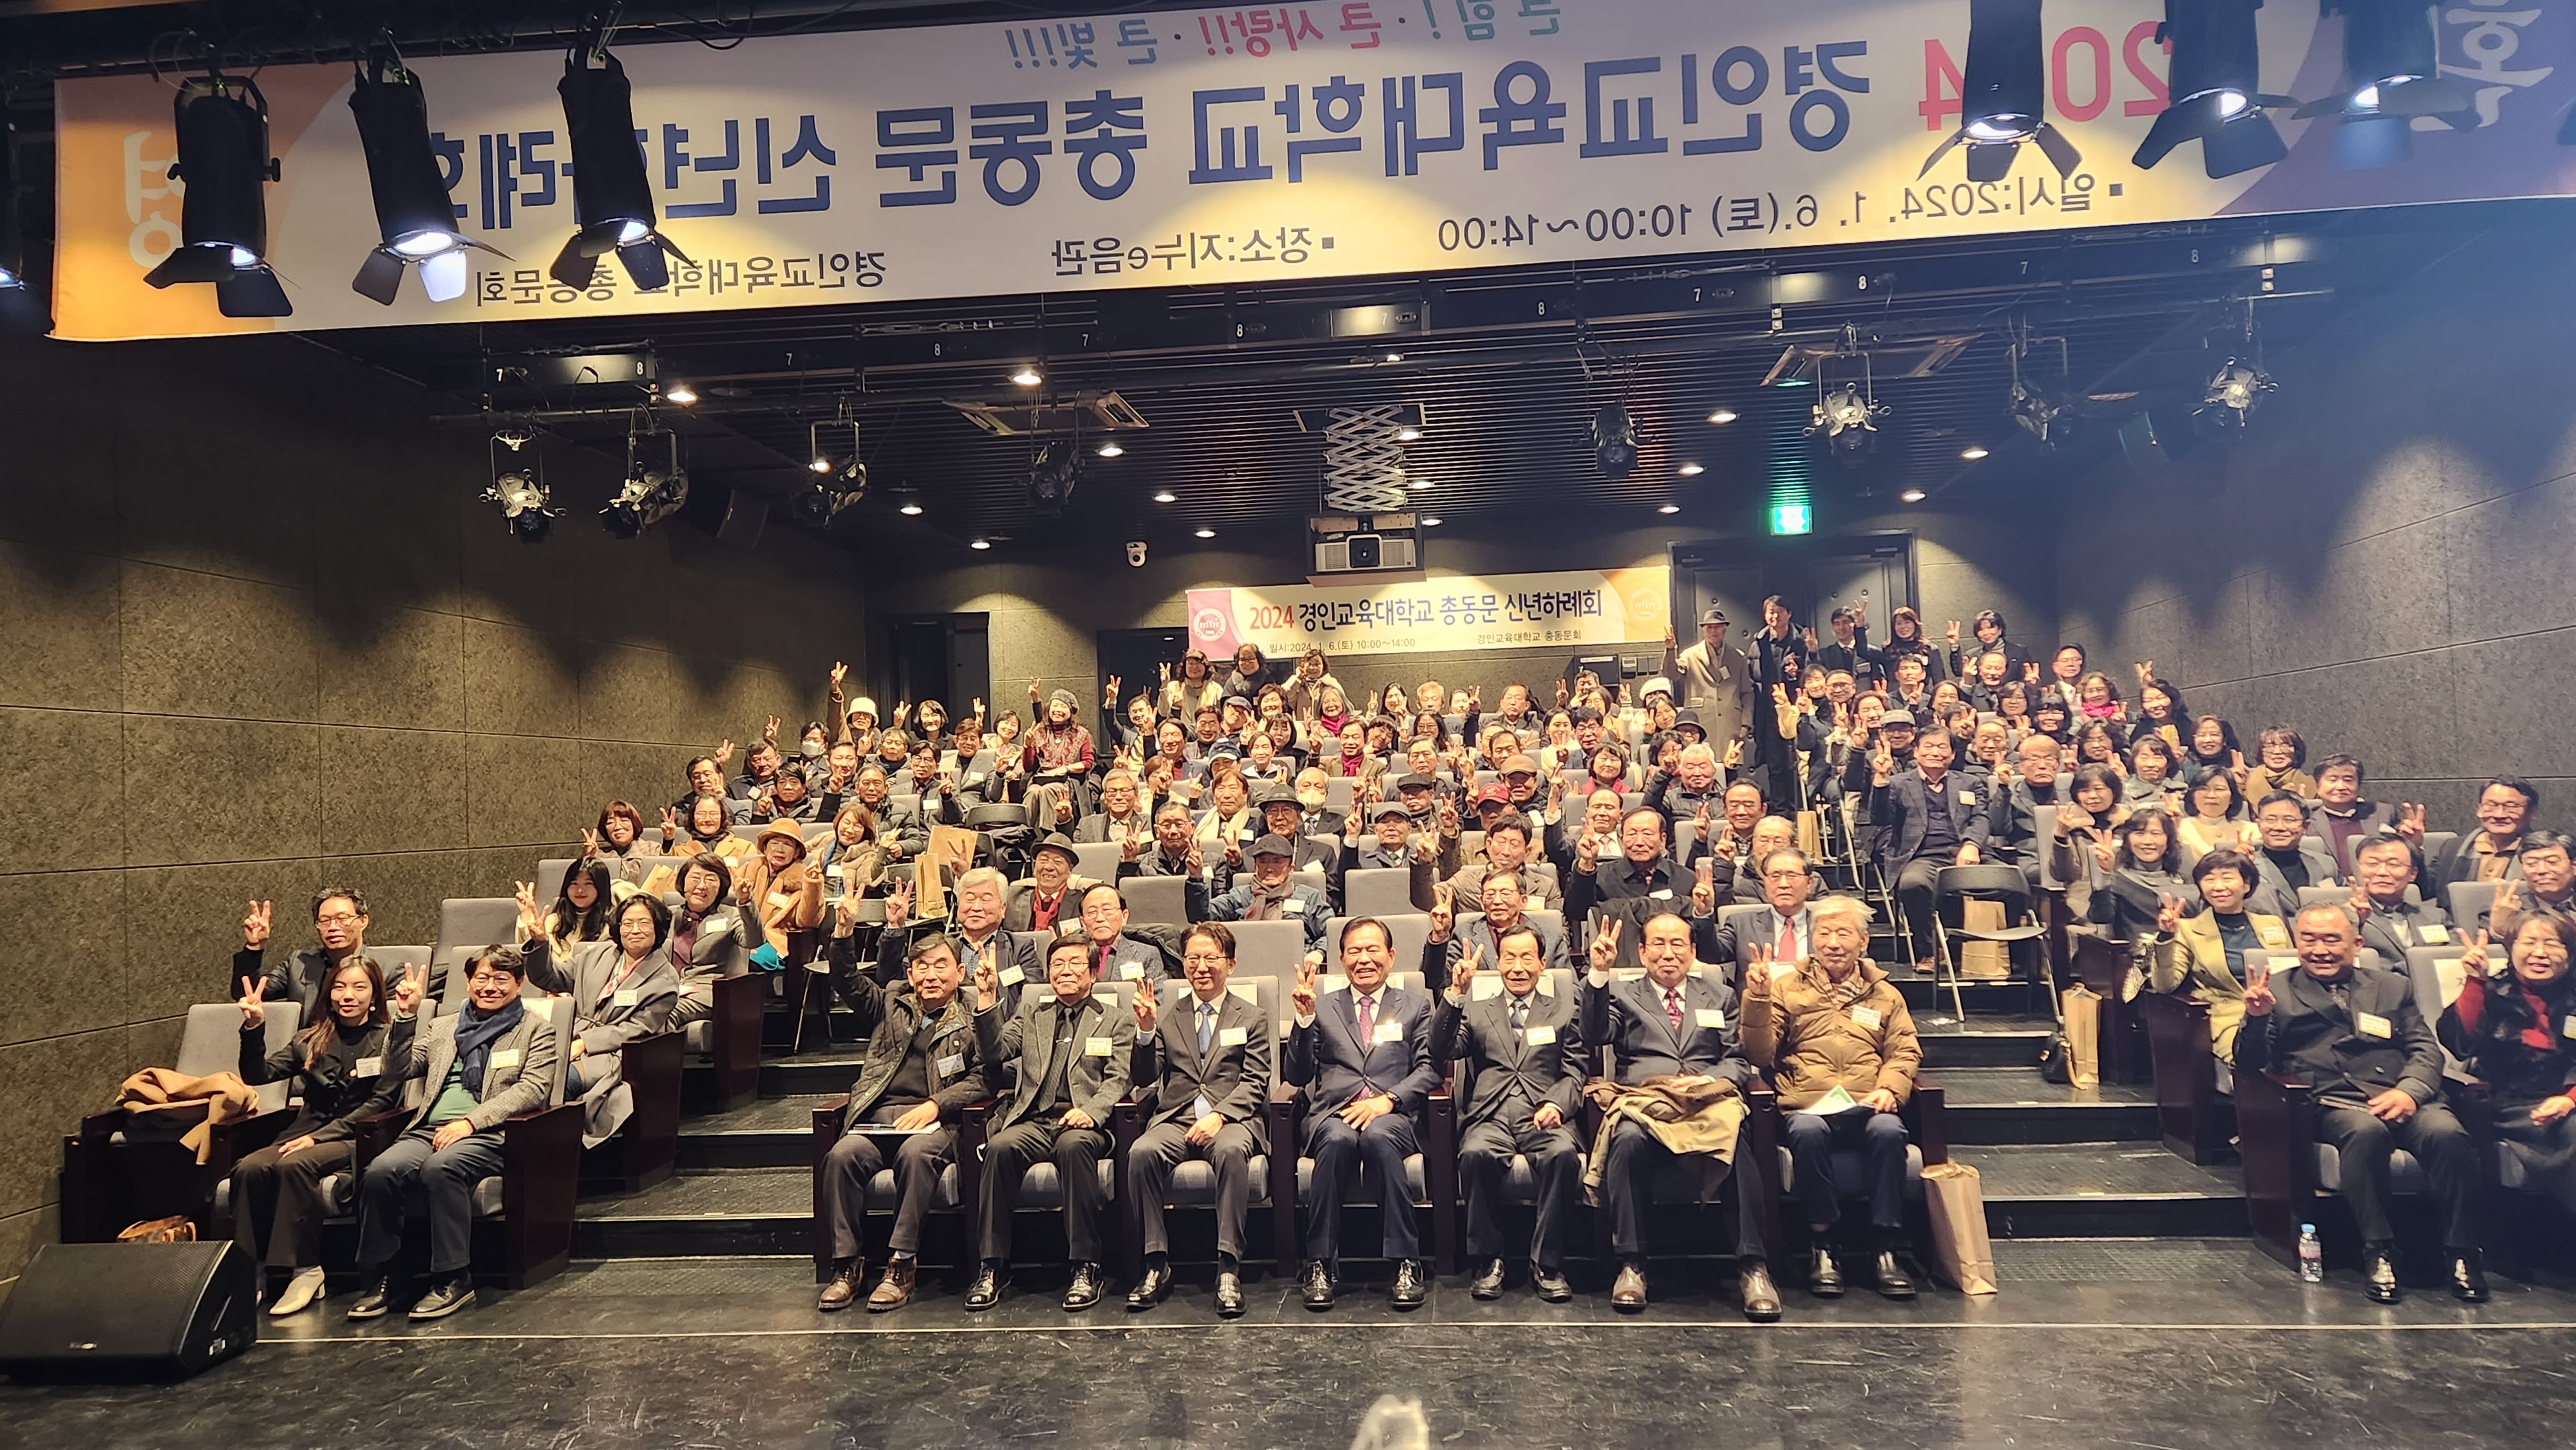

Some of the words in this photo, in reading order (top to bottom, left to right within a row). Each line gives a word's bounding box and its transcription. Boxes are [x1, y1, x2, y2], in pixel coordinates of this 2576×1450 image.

[1859, 276, 1866, 290] 8
[1694, 288, 1701, 301] 7
[1538, 301, 1545, 315] 8
[1236, 324, 1243, 337] 8
[1082, 334, 1089, 346] 7
[934, 343, 941, 356] 8
[786, 353, 793, 366] 7
[496, 368, 504, 382] 7
[636, 361, 643, 375] 8
[1249, 605, 1295, 630] 2024
[1298, 598, 1435, 632] 경인교육대학교
[1439, 595, 1500, 626] 총동문
[1504, 588, 1602, 623] 신년하례회
[1476, 631, 1542, 645] 경인교육대학교
[1269, 641, 1312, 654] 일시:2024
[1357, 637, 1416, 650] 10:00~14:00
